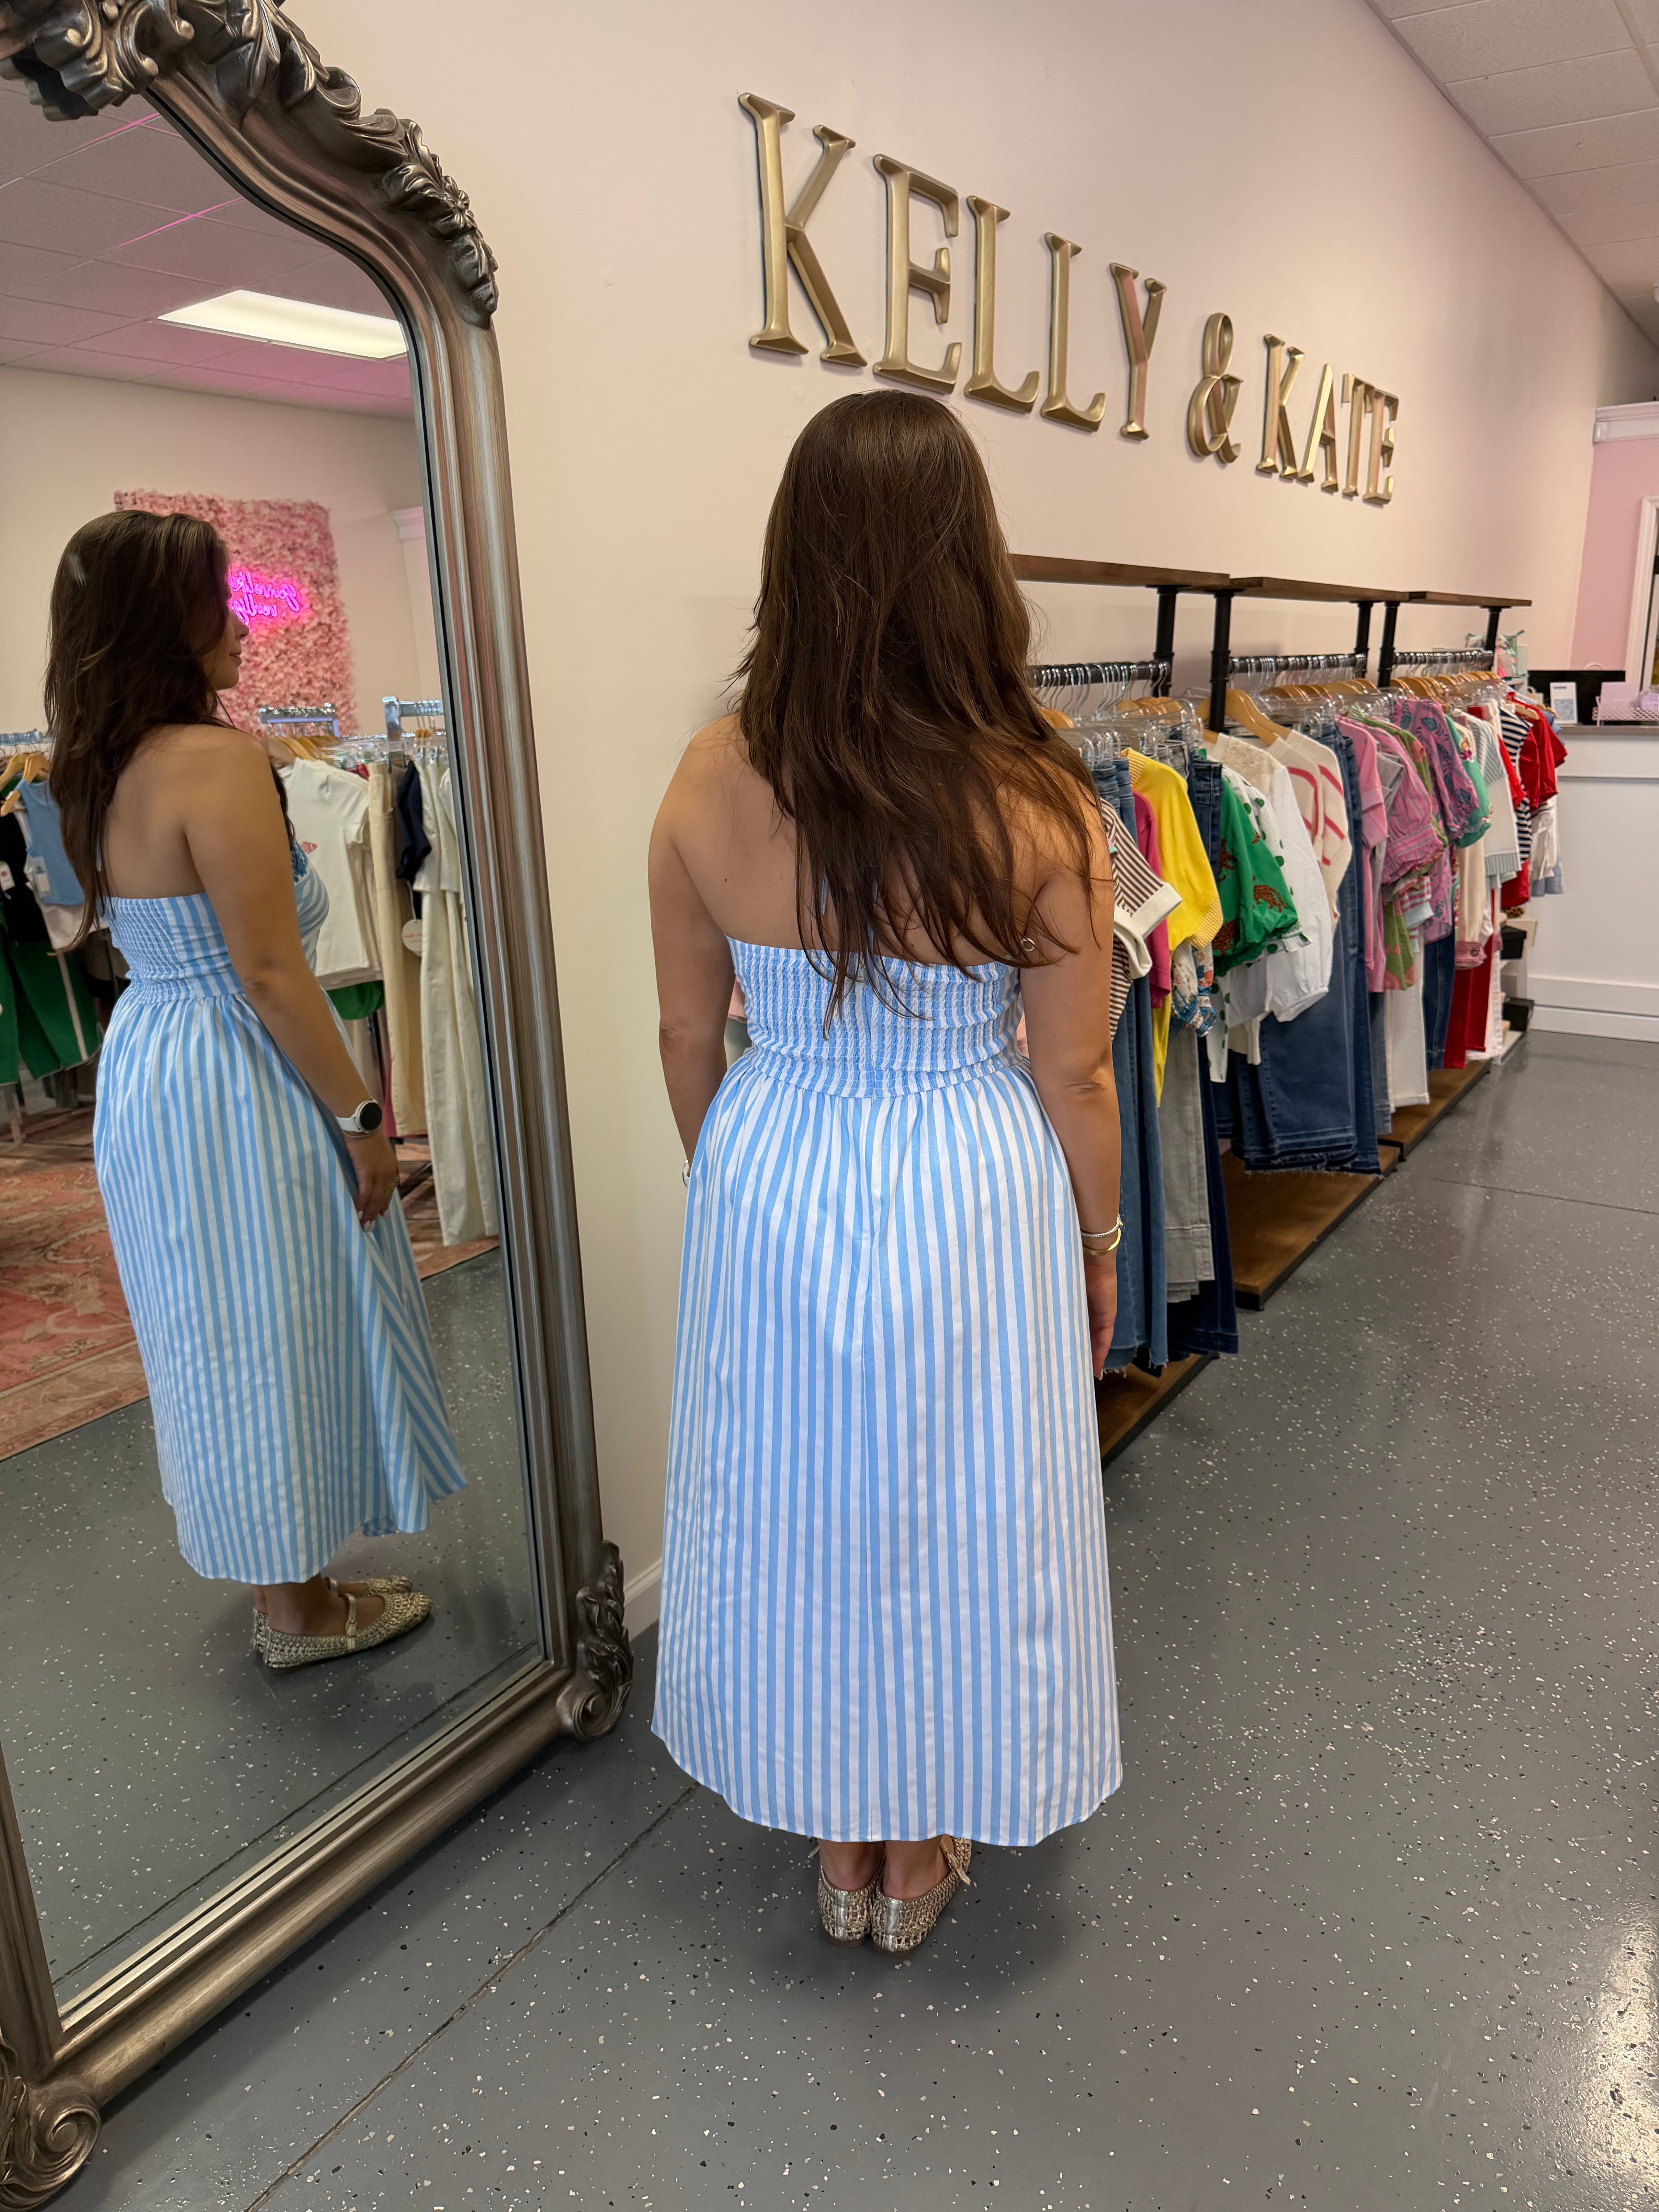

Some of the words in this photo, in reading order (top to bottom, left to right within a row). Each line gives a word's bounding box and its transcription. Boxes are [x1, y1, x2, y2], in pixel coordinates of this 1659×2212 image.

[738, 92, 1166, 440] KELLY
[1187, 312, 1243, 464] &
[1256, 333, 1398, 504] KATE
